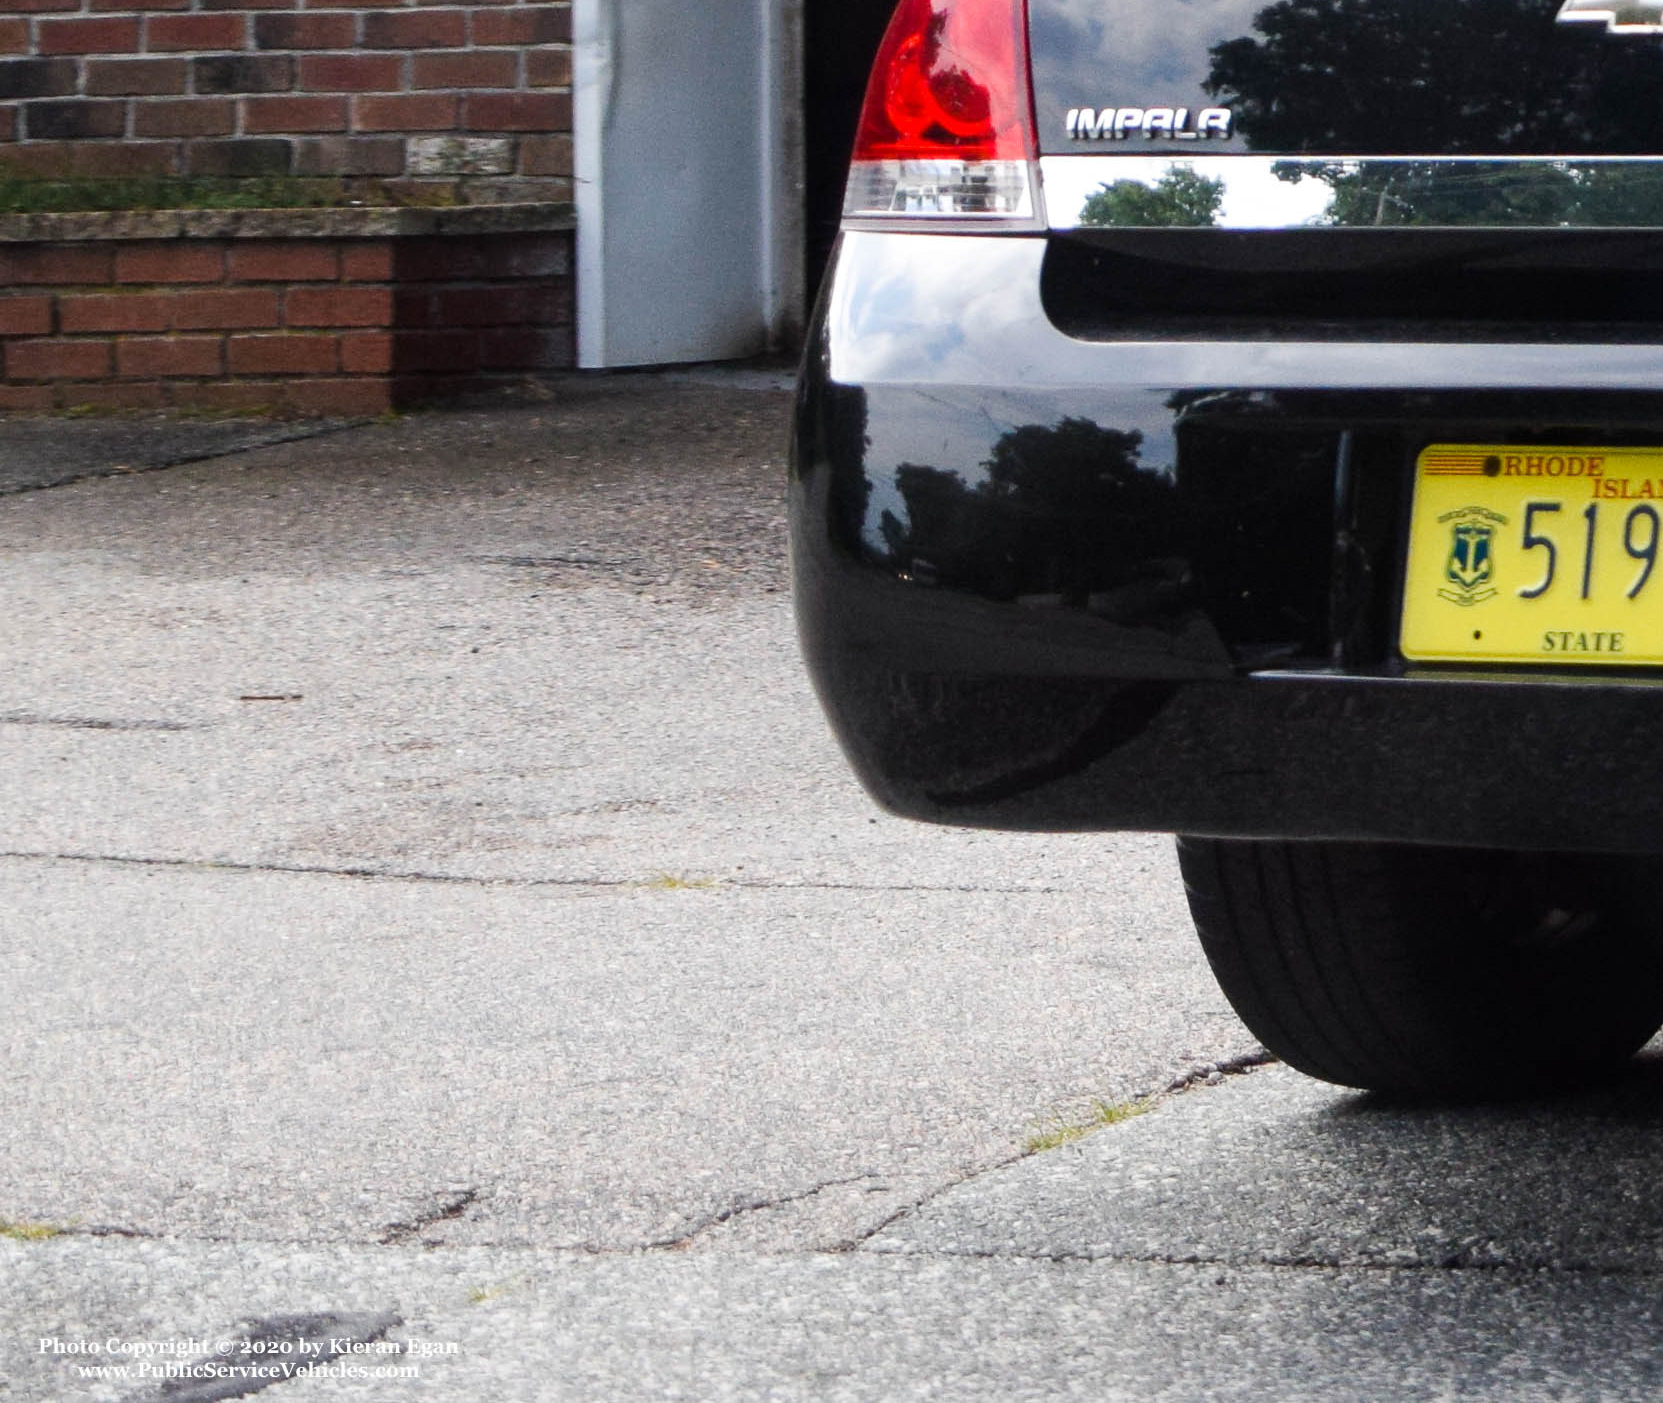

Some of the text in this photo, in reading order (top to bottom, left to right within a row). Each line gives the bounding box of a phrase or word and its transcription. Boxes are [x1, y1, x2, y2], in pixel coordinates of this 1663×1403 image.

[1065, 107, 1233, 140] IMPALA
[1503, 455, 1605, 478] RHODE
[1518, 501, 1661, 601] 519
[1541, 631, 1625, 653] STATE
